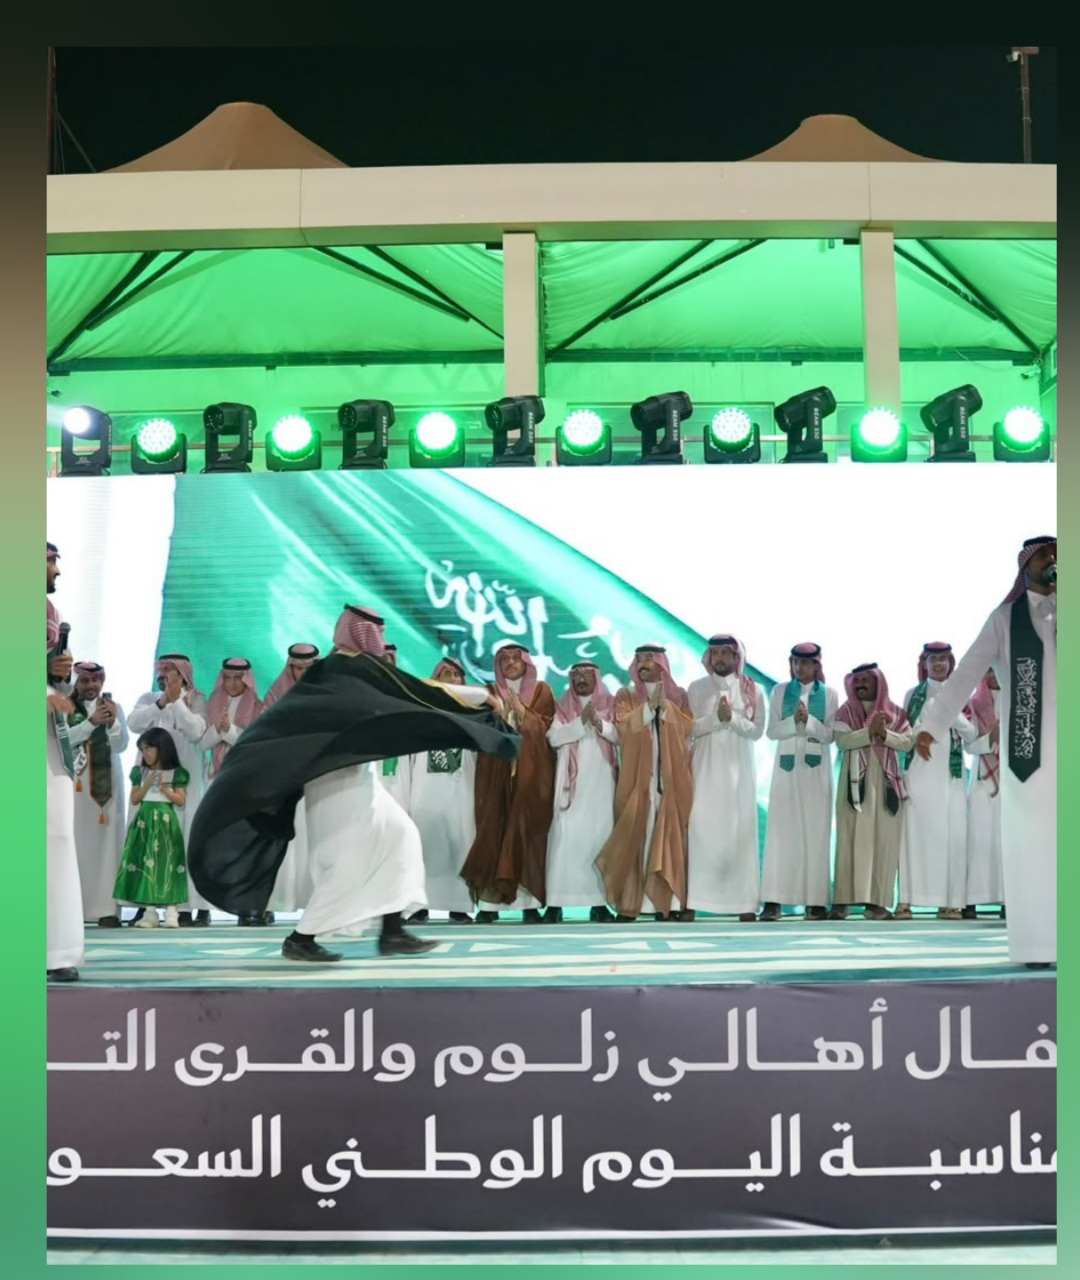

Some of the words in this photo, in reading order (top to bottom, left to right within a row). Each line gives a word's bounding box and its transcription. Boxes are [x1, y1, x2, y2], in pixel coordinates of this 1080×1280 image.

[174, 1008, 416, 1087] والقرى
[434, 1008, 619, 1088] زلوم
[638, 997, 887, 1102] أهالي
[301, 1114, 563, 1208] الوطني
[582, 1113, 801, 1193] اليوم
[820, 1110, 1057, 1191] ناسبة
